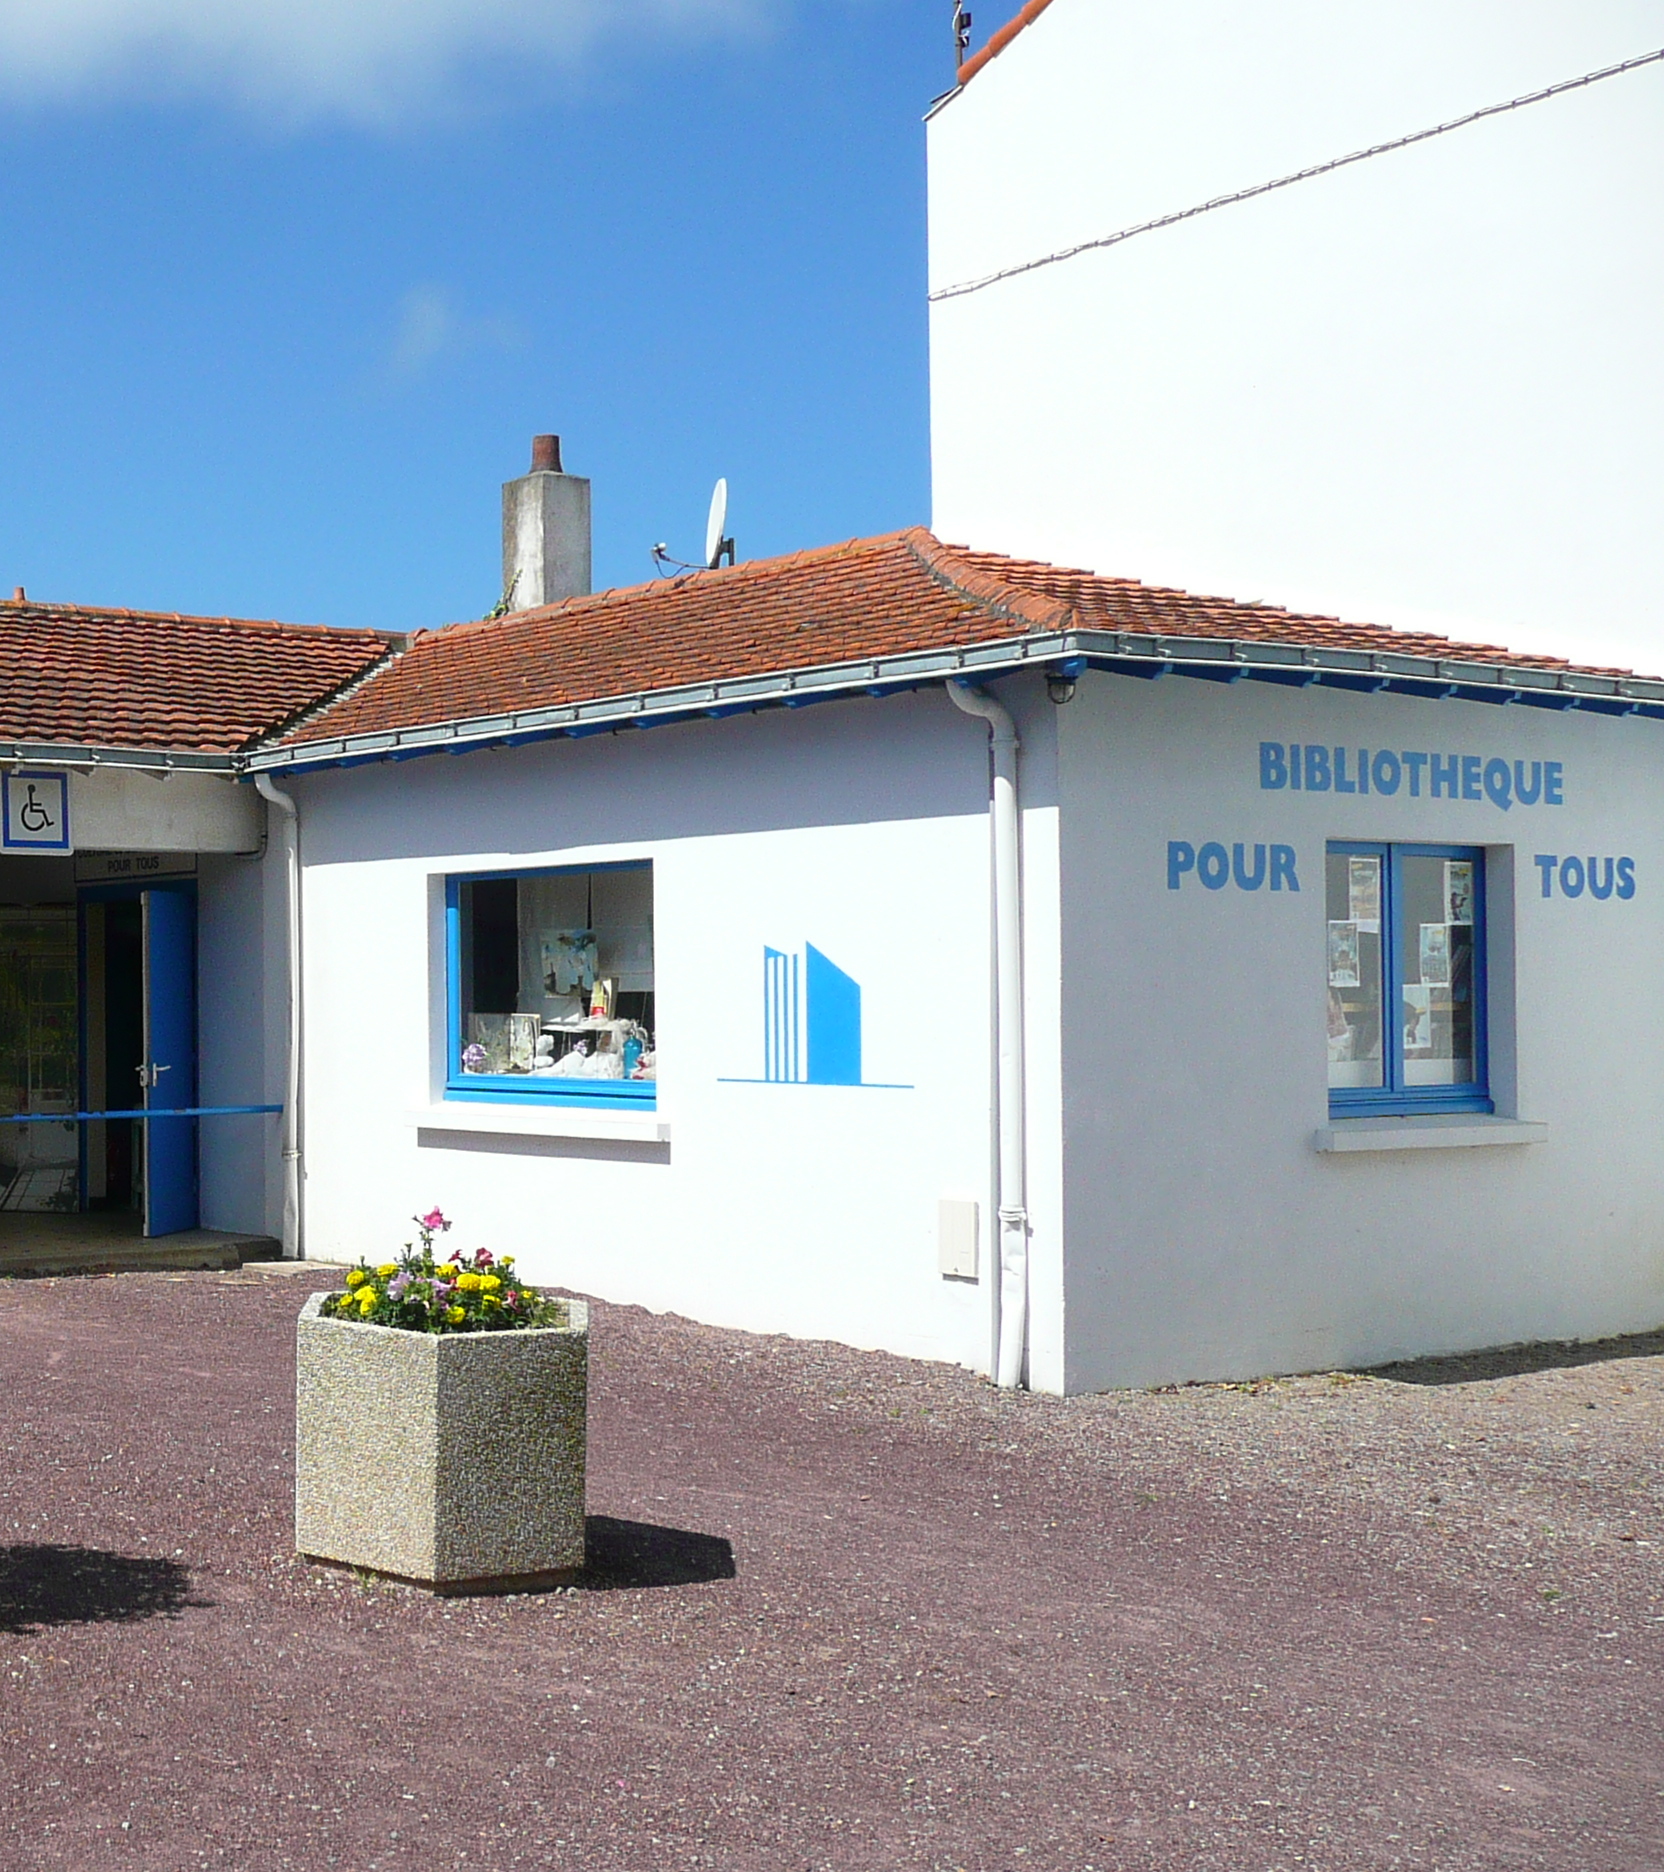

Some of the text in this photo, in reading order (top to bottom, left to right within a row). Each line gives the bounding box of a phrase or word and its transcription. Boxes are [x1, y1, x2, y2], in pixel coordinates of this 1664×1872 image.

[1259, 741, 1564, 812] BIBLIOTHEQUE
[107, 855, 160, 872] POUR TOUS
[1167, 840, 1636, 900] POUR TOUS
